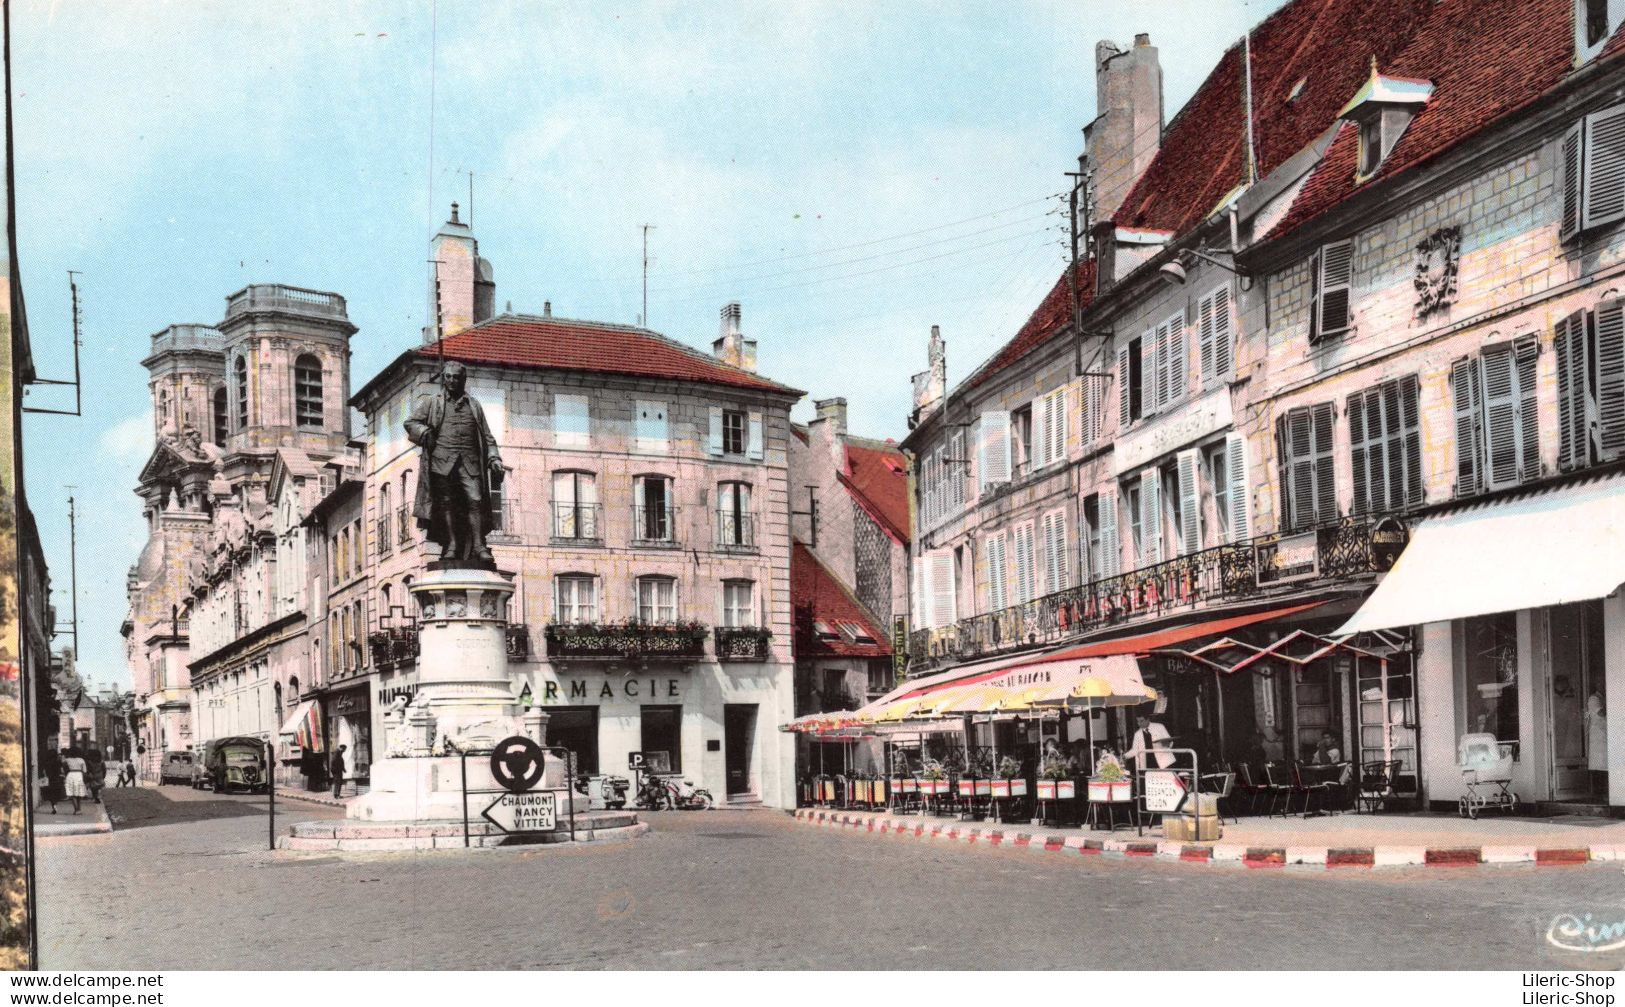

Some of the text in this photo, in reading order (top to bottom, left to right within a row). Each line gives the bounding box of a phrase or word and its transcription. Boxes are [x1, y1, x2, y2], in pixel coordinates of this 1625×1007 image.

[895, 615, 905, 677] FLEURS
[633, 754, 643, 767] P
[501, 796, 553, 807] CHAUMONT
[515, 807, 553, 817] NANCY
[513, 818, 552, 828] VITTEL
